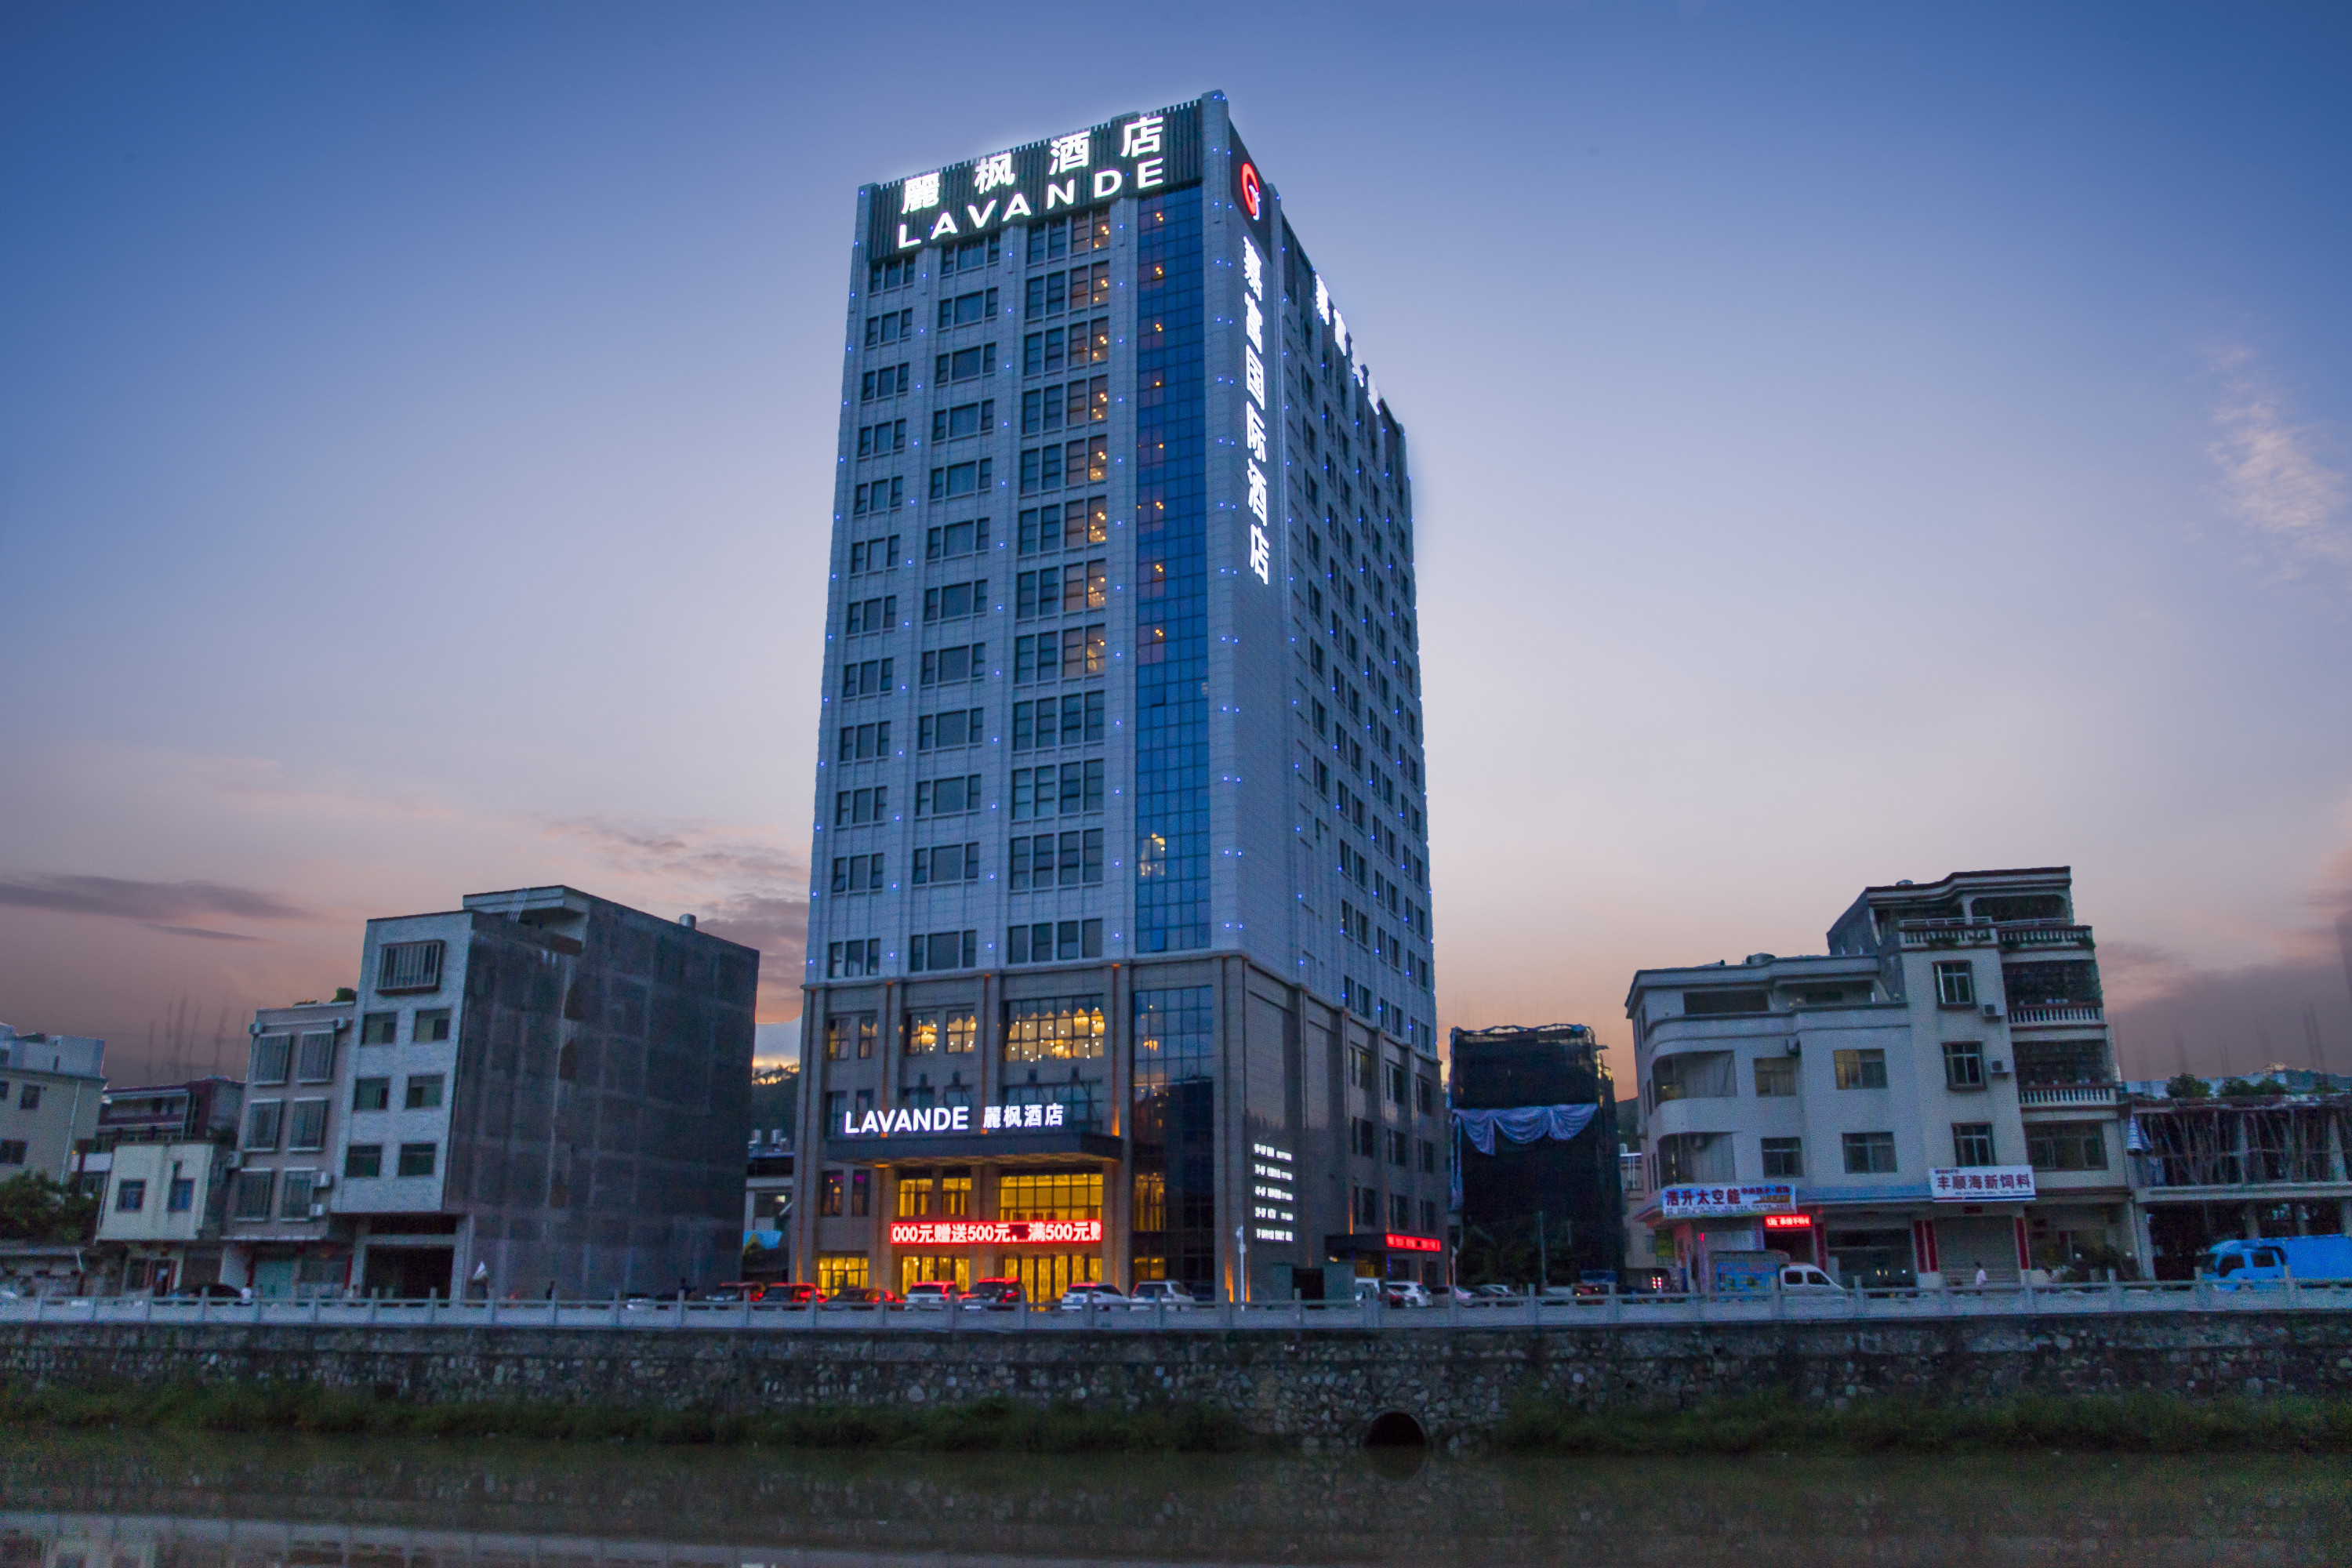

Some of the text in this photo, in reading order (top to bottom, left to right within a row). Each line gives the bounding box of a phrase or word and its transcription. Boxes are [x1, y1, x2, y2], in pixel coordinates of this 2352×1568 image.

[898, 158, 1164, 249] LAVANDE
[901, 116, 1163, 214] 麗枫酒店
[844, 1105, 969, 1134] LAVANDE
